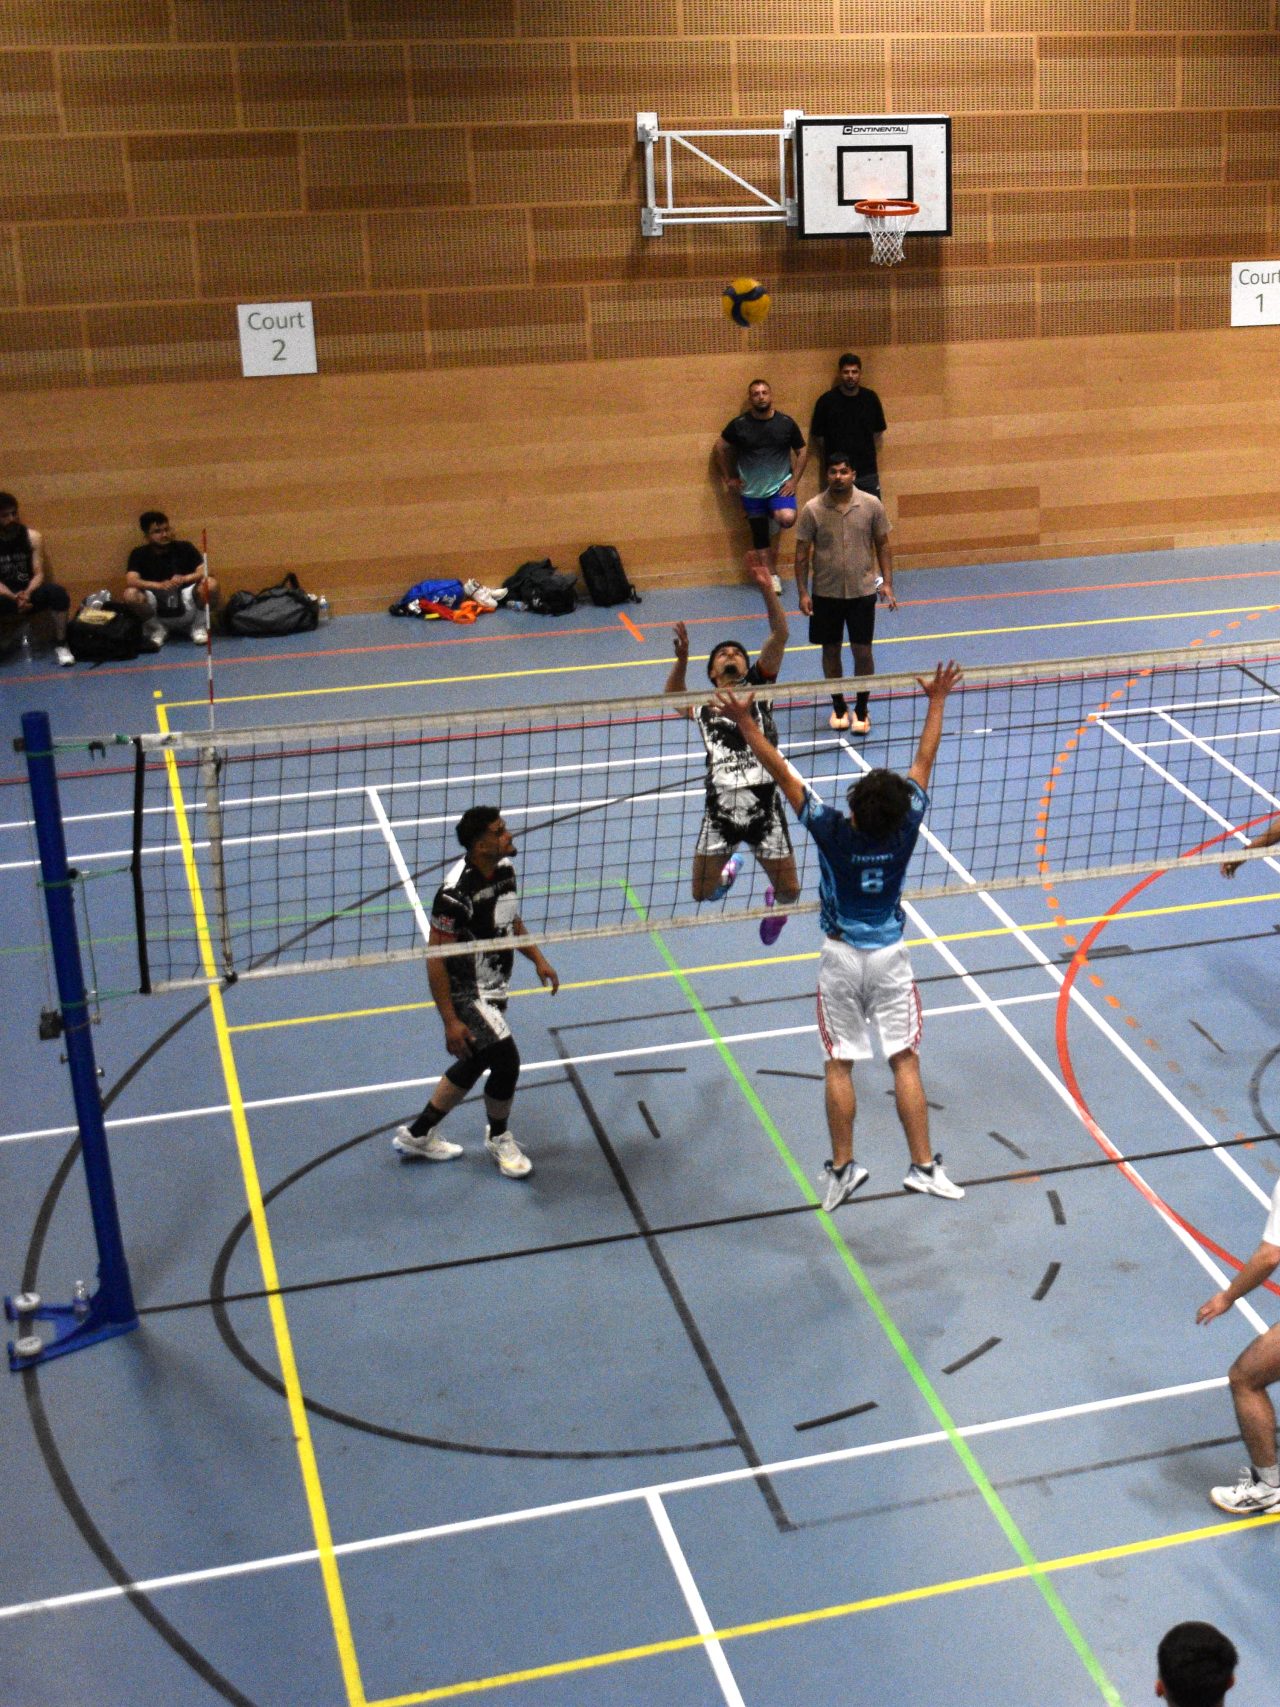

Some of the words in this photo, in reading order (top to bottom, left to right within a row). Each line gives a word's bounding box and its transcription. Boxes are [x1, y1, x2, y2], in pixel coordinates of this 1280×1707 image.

[843, 125, 906, 134] CONTINENTAL
[1255, 293, 1264, 313] 1
[247, 312, 306, 331] Court
[272, 339, 287, 361] 2
[861, 868, 884, 893] 6
